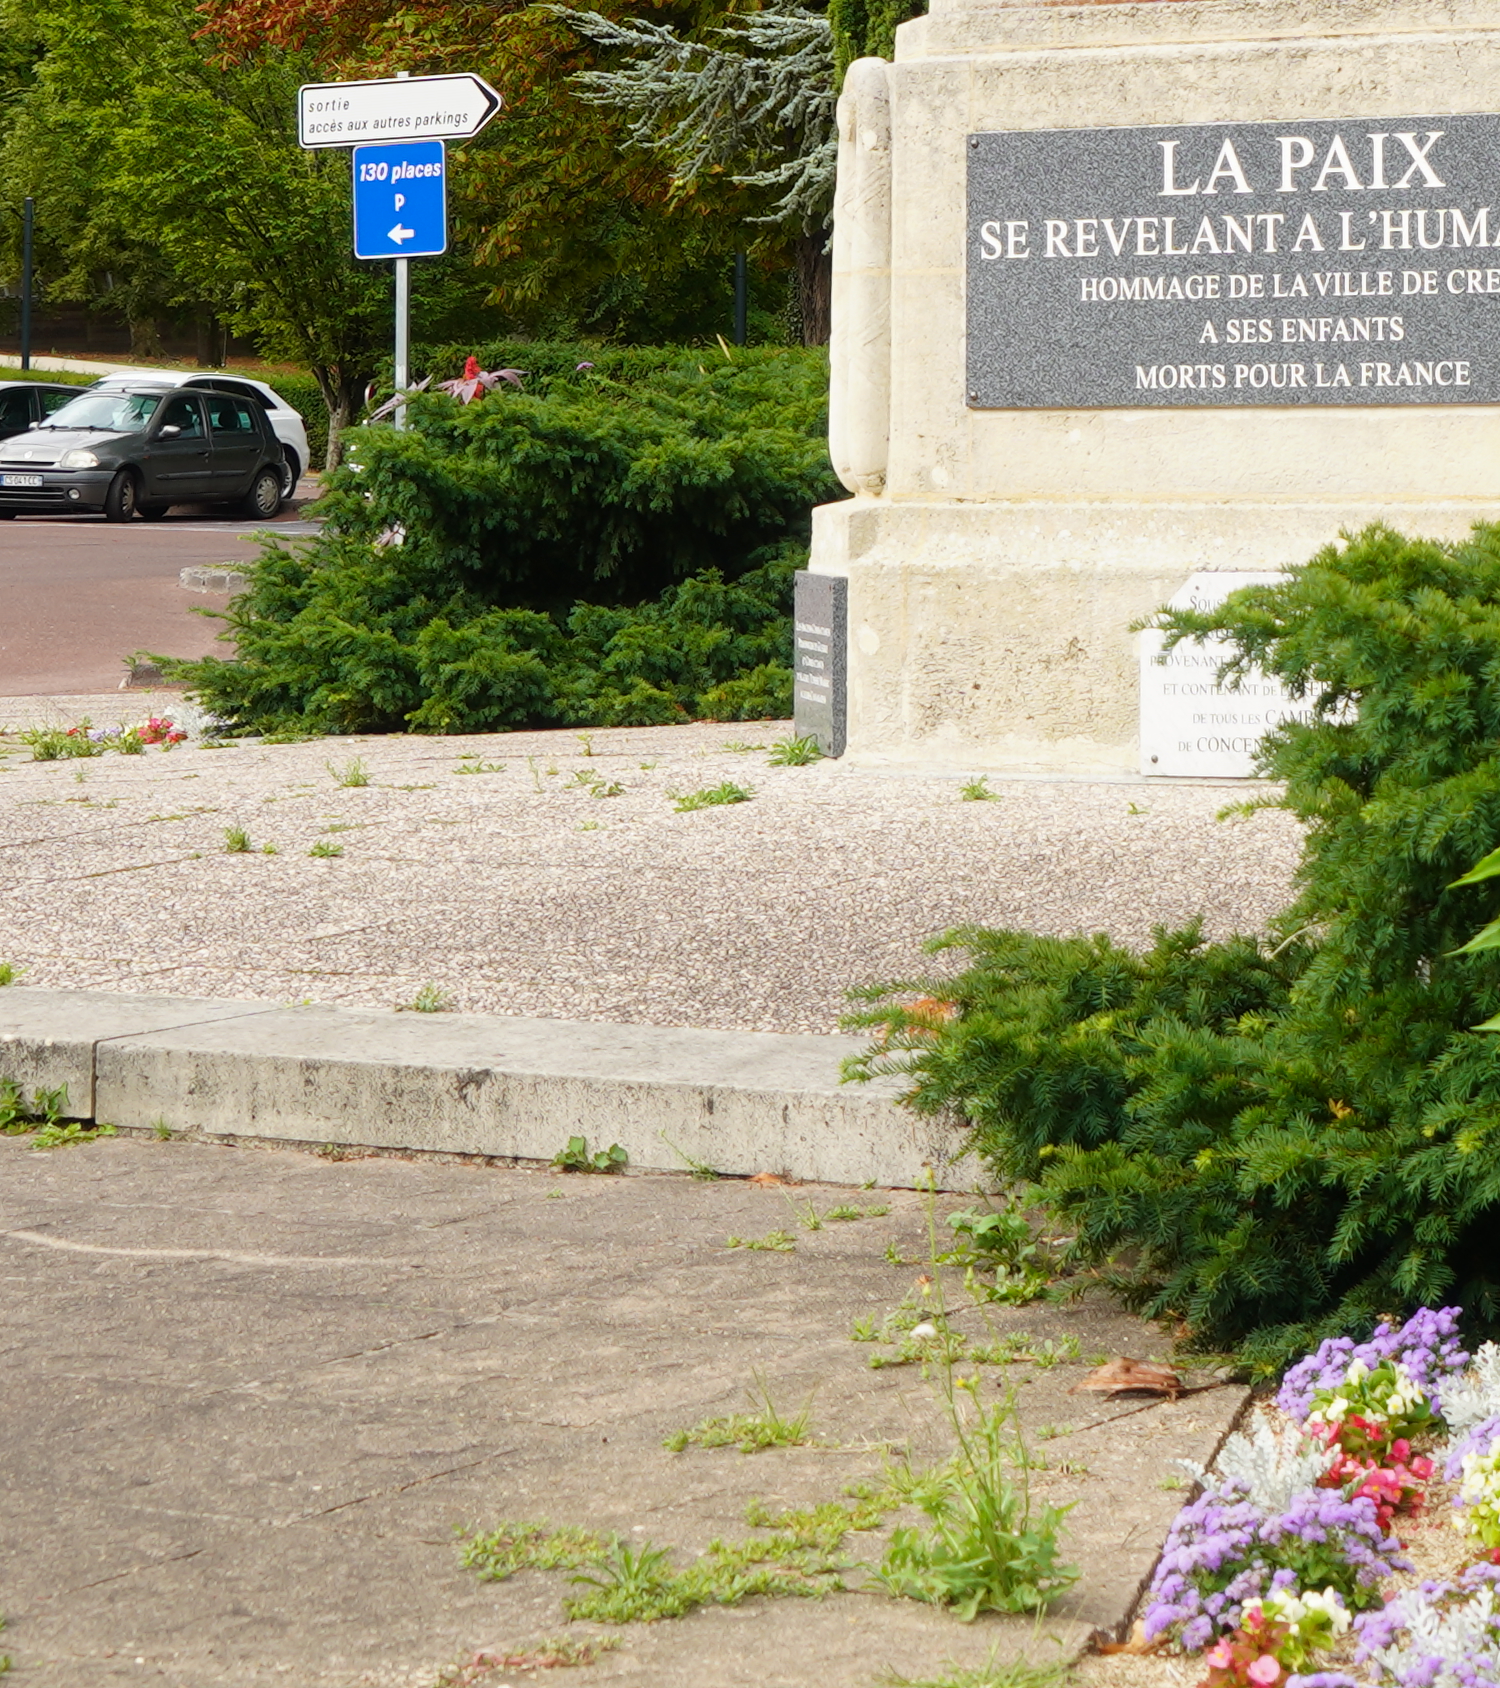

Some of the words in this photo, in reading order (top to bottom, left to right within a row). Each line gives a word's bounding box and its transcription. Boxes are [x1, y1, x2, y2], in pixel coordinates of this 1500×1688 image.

[308, 97, 350, 113] sortie
[308, 118, 343, 134] accès
[347, 119, 369, 131] aux
[373, 115, 412, 130] autres
[414, 111, 469, 130] parkings
[359, 162, 388, 182] 130
[390, 161, 442, 185] places
[1157, 137, 1254, 196] LA
[1275, 129, 1447, 194] PAIX
[394, 193, 405, 212] P
[980, 220, 1031, 260] SE
[1043, 213, 1285, 258] REVELANT
[1291, 212, 1325, 252] A
[1080, 273, 1221, 302] HOMMAGE
[1228, 273, 1265, 299] DE
[1272, 272, 1310, 298] LA
[1311, 270, 1394, 297] VILLE
[1401, 269, 1439, 296] DE
[1198, 320, 1219, 344] A
[1226, 318, 1273, 344] SES
[1281, 315, 1405, 344] ENFANTS
[1135, 363, 1226, 390] MORTS
[1234, 363, 1308, 389] POUR
[1314, 363, 1352, 388] LA
[1359, 360, 1471, 387] FRANCE
[1163, 683, 1178, 696] ET
[1263, 685, 1277, 697] DE
[1192, 713, 1207, 724] DE
[1210, 713, 1238, 725] TOUS
[1241, 714, 1261, 725] LES
[1178, 741, 1192, 752] DE
